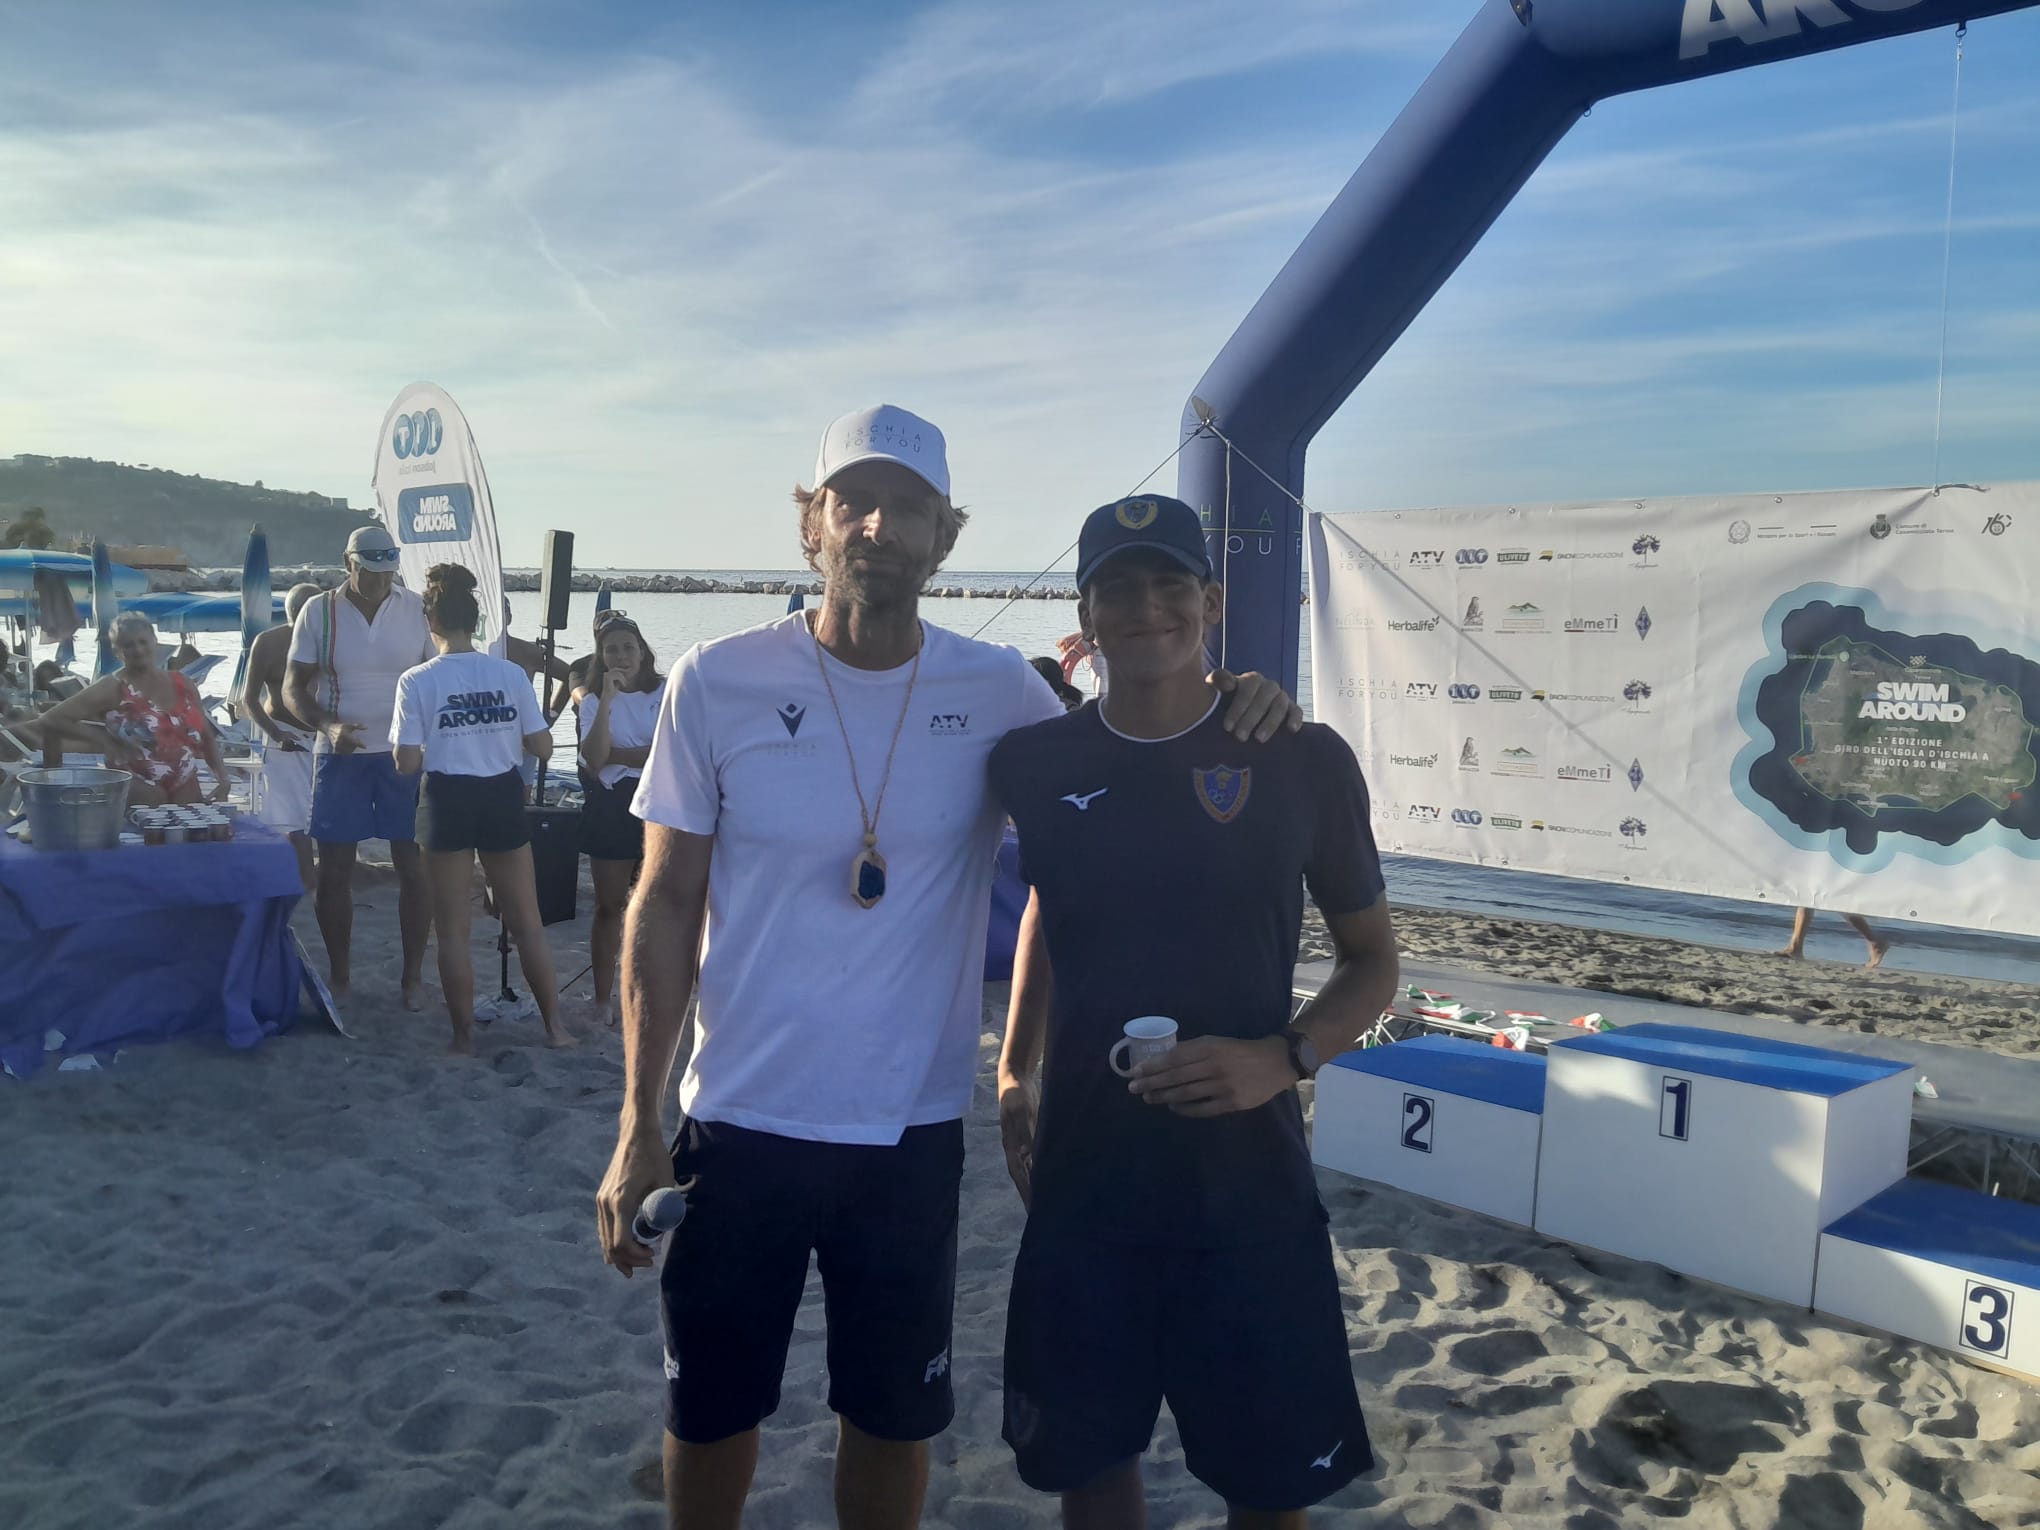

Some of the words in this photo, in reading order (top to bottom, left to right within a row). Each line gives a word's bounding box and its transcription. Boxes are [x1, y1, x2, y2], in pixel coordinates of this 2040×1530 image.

[1409, 550, 1445, 564] ATV
[1388, 619, 1435, 631] Herbalife
[1406, 683, 1438, 696] ATV
[1877, 681, 1949, 702] SWIM
[447, 690, 505, 709] SWIM
[438, 706, 517, 730] AROUND
[1858, 701, 1966, 722] AROUND
[930, 714, 968, 728] ATV
[1892, 737, 1942, 747] EDIZIONE
[1390, 754, 1434, 767] Herbalife
[1834, 745, 1859, 753] GIRO
[1929, 750, 1978, 760] D'ISCHIA
[1982, 752, 1989, 761] A
[1874, 758, 1909, 768] NUOTO
[1408, 804, 1441, 819] ATV
[1665, 1081, 1690, 1137] 1
[1405, 1099, 1431, 1150] 2
[1965, 1287, 2008, 1350] 3
